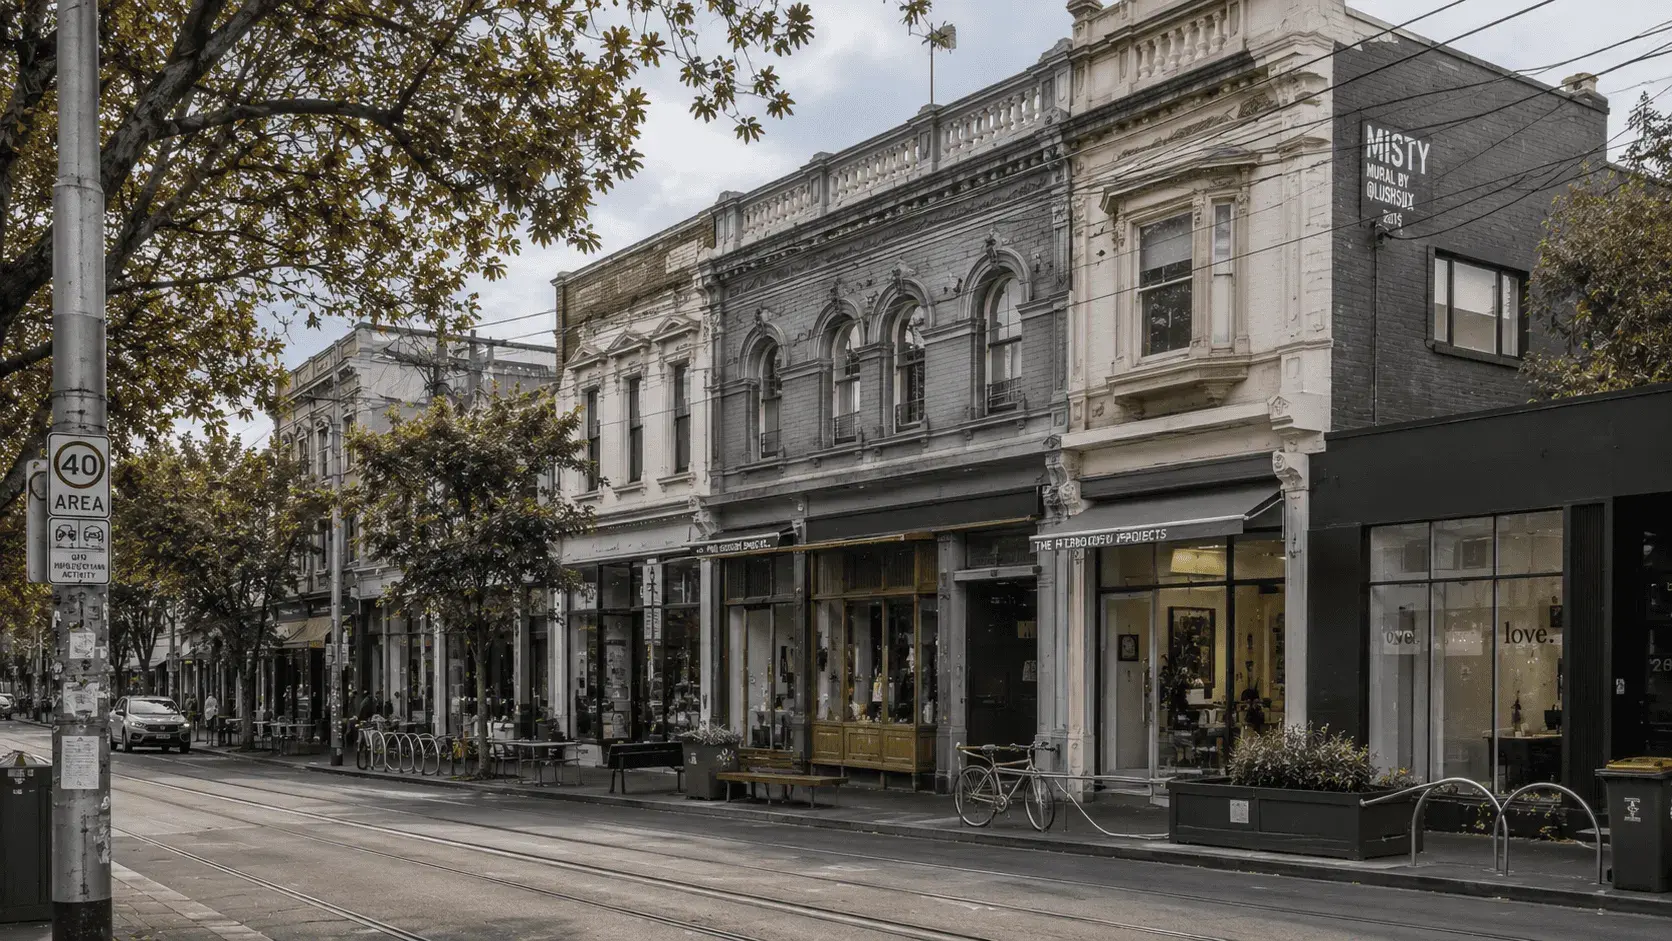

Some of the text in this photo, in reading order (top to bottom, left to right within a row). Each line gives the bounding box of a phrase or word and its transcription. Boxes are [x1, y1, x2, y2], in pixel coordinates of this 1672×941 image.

[1367, 124, 1430, 175] MISTY
[1367, 162, 1409, 188] MURAL BY
[61, 453, 98, 476] 40
[54, 494, 104, 513] AREA
[1504, 620, 1554, 644] love.
